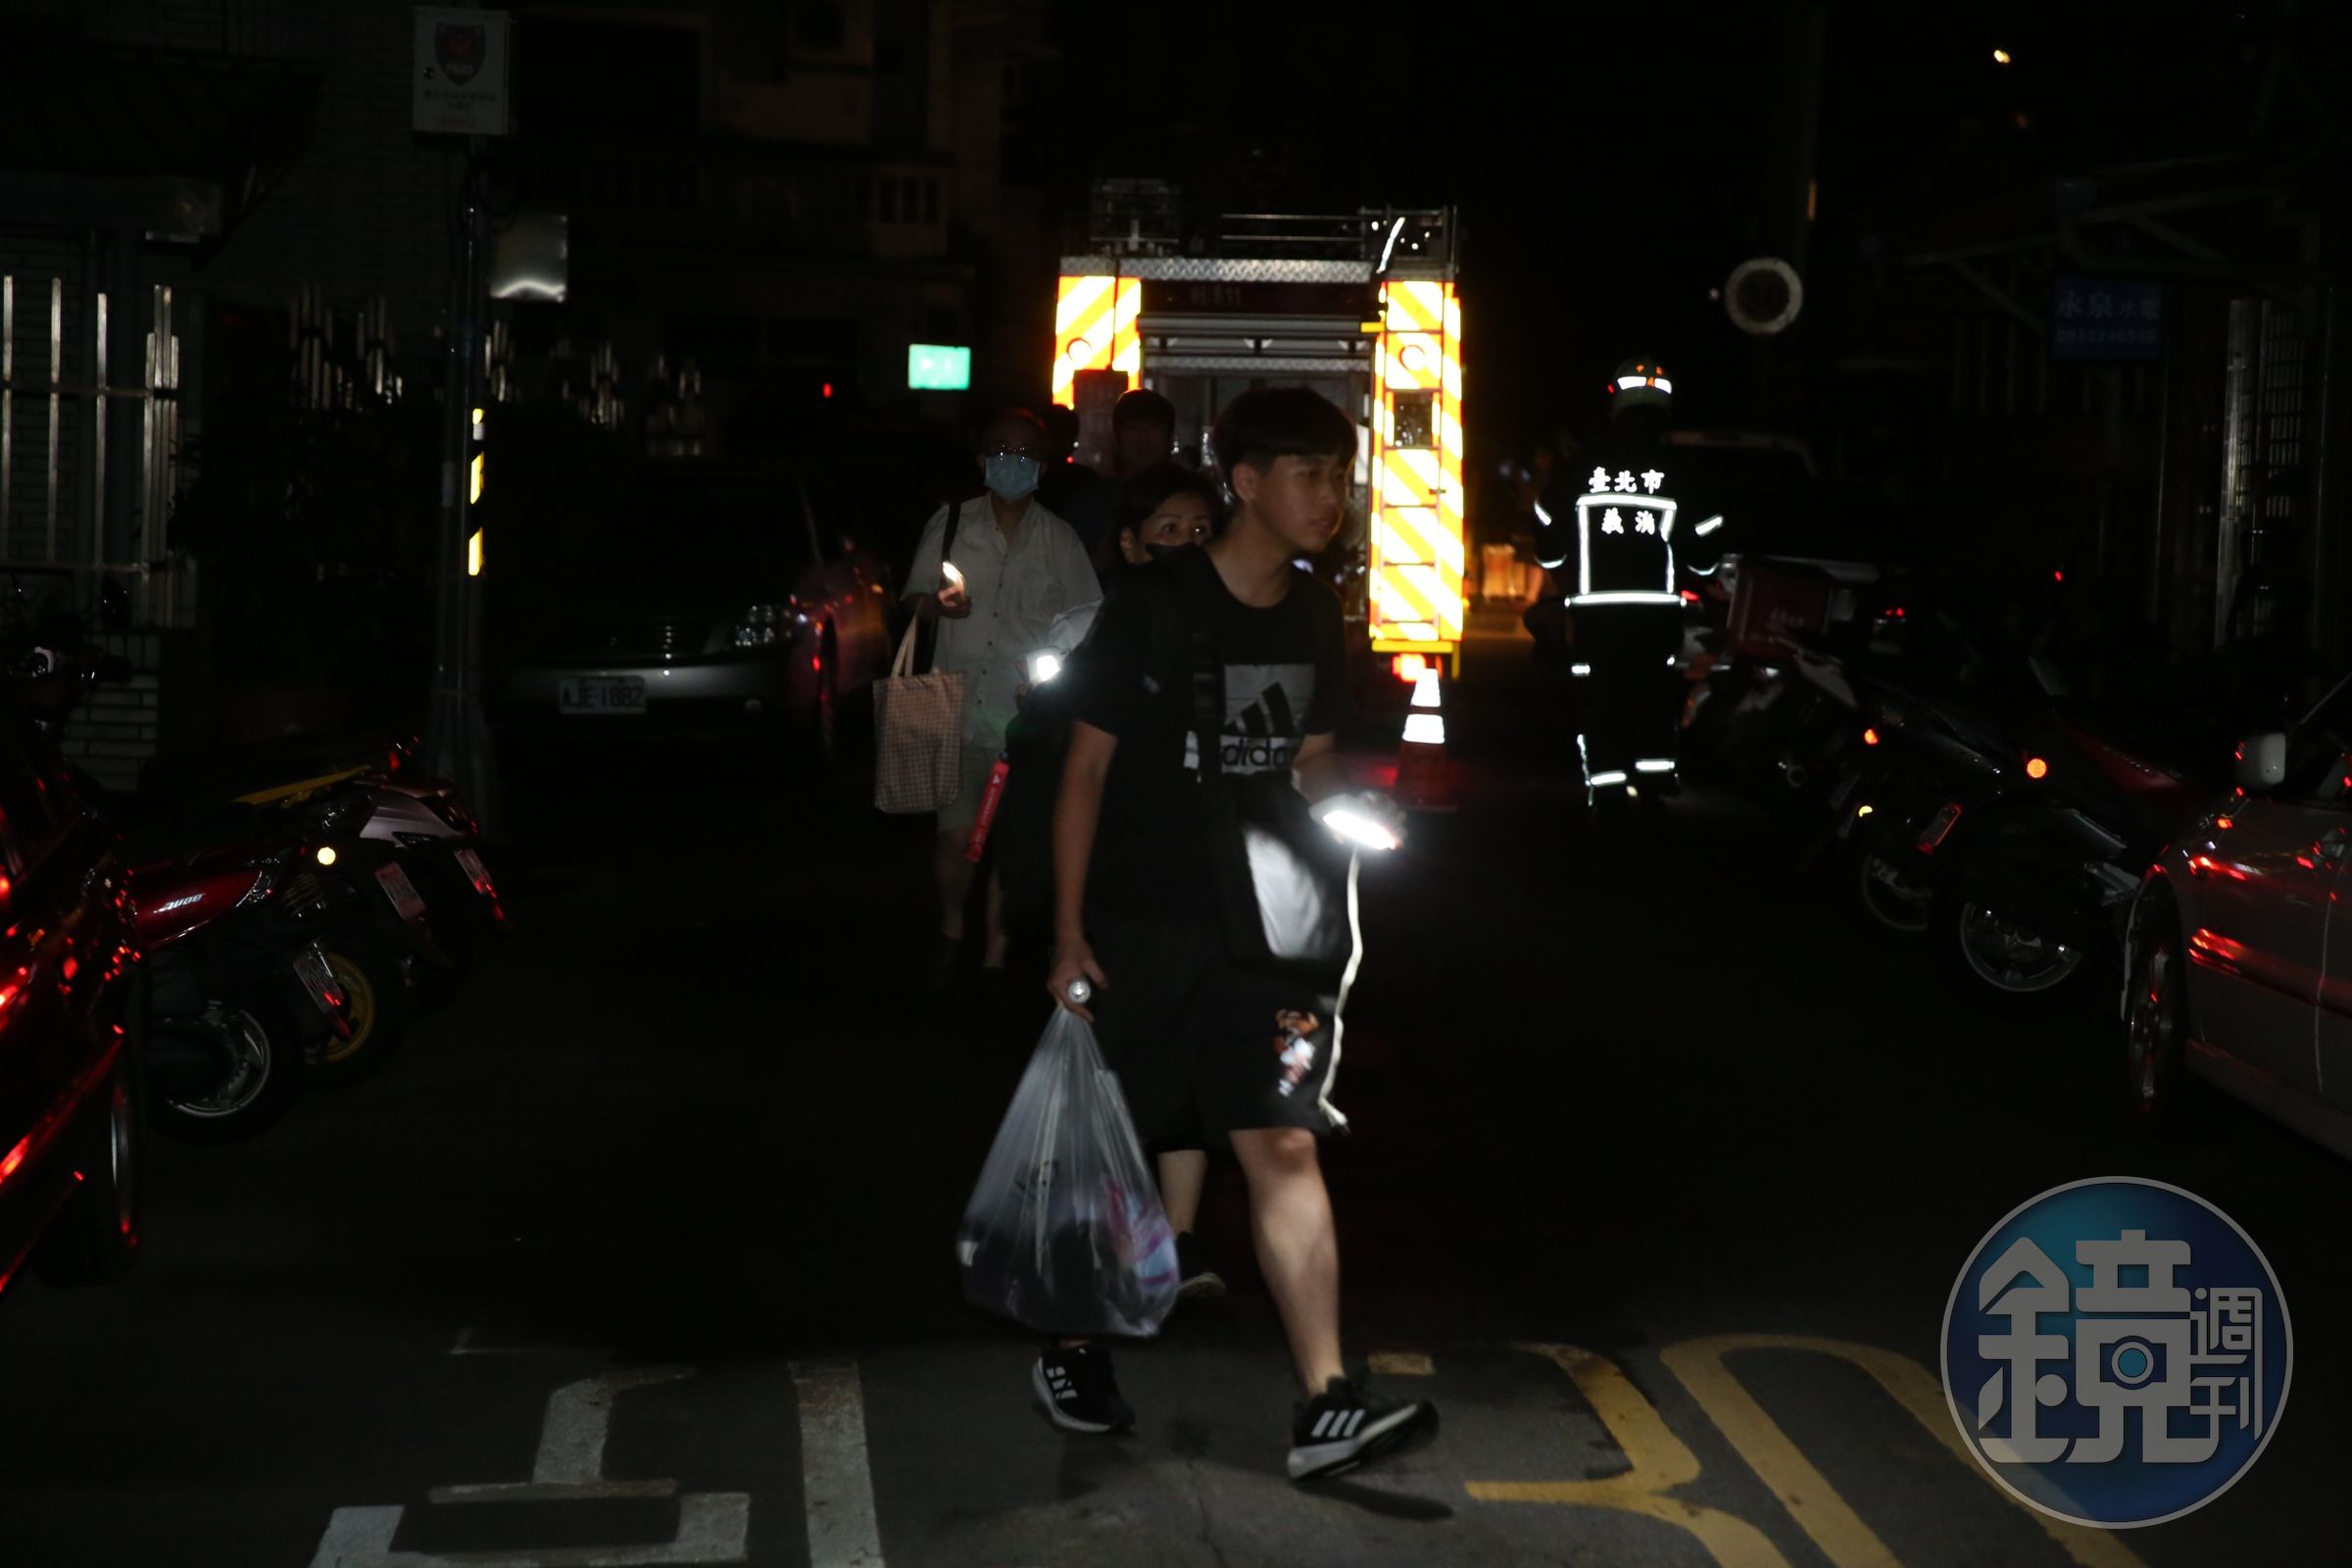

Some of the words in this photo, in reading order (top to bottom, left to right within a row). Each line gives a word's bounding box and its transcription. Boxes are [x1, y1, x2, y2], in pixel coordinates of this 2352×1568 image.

[1588, 466, 1665, 494] 臺北市
[1601, 507, 1656, 535] 義消
